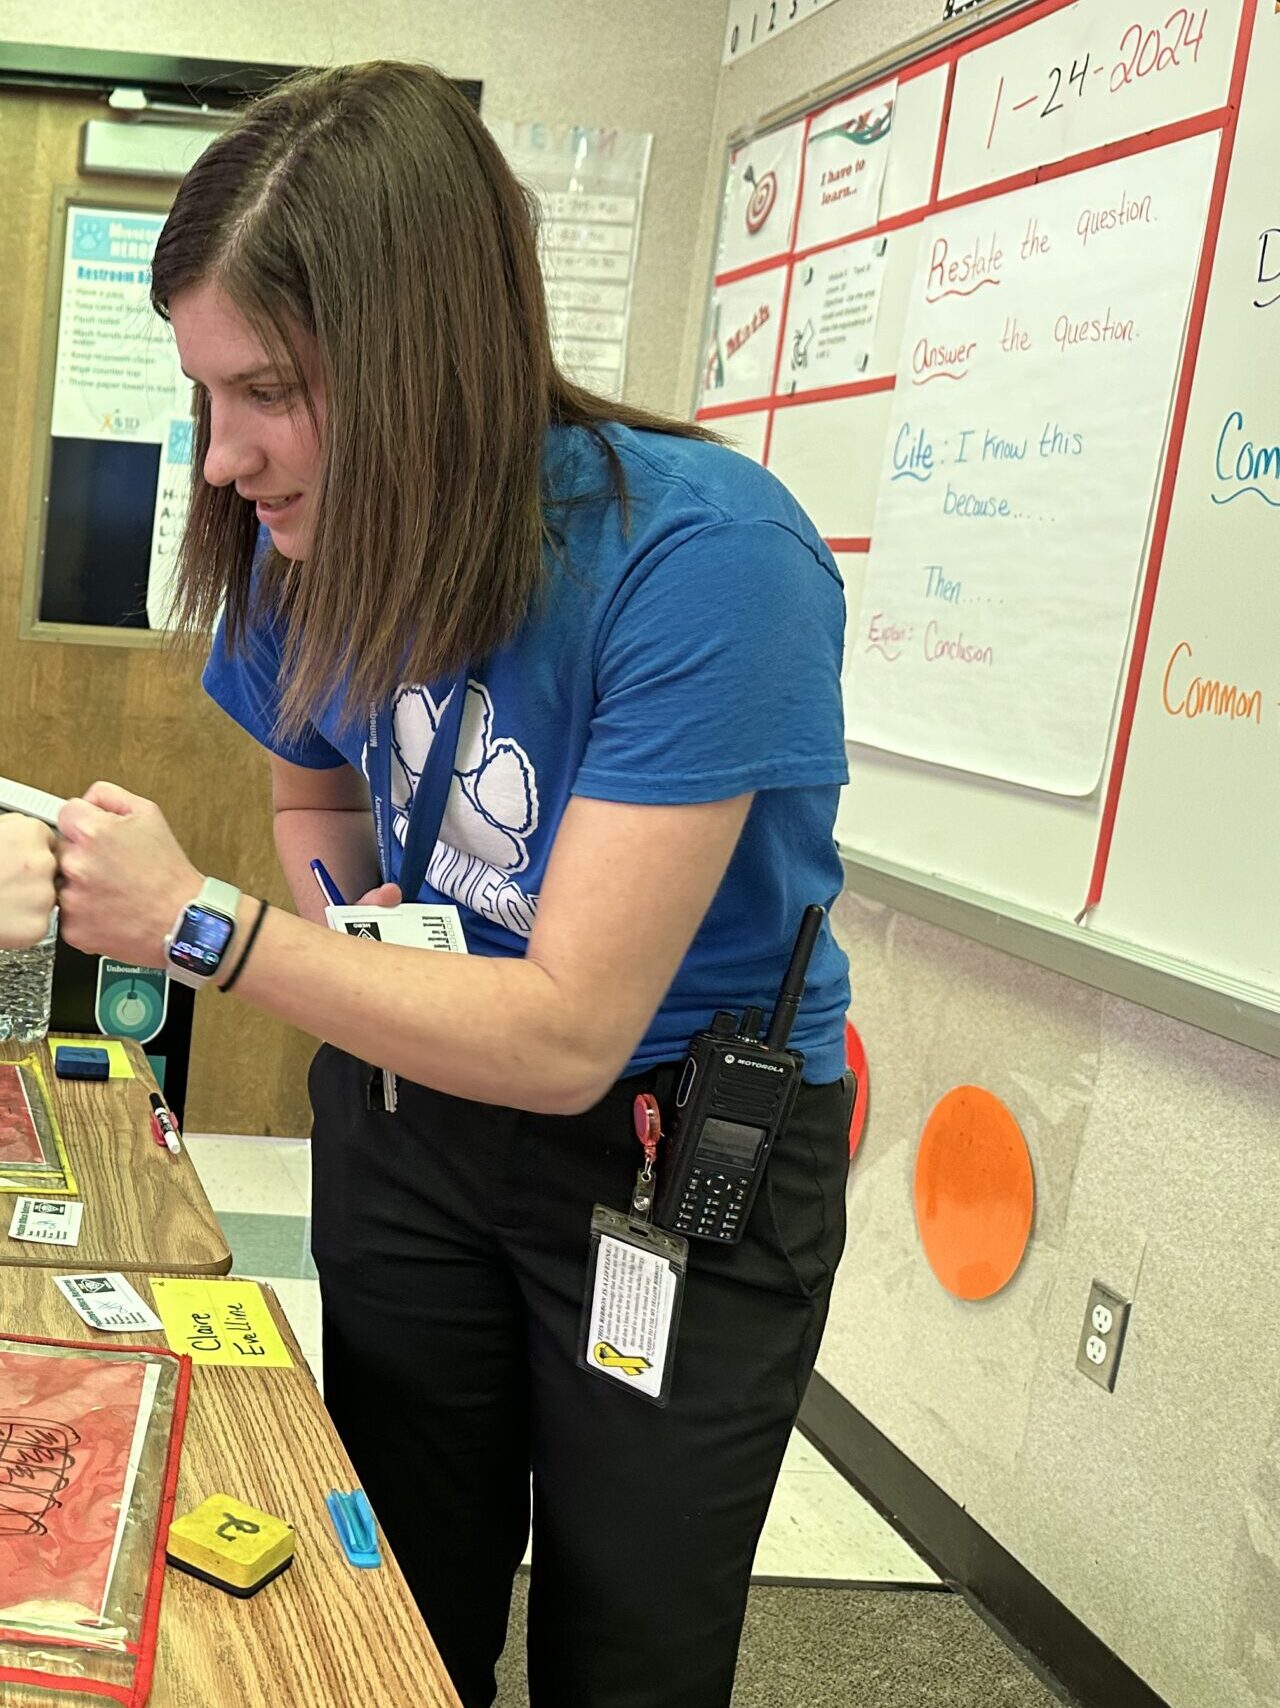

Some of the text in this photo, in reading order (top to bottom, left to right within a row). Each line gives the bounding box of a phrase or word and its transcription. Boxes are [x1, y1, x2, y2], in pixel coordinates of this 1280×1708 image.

[987, 9, 1208, 150] 1-24-2024
[928, 238, 1004, 290] Restate
[1020, 218, 1051, 260] the
[1000, 316, 1032, 352] the
[1039, 421, 1083, 458] this
[1162, 641, 1263, 724] Common
[736, 1058, 785, 1074] MOTOROLA
